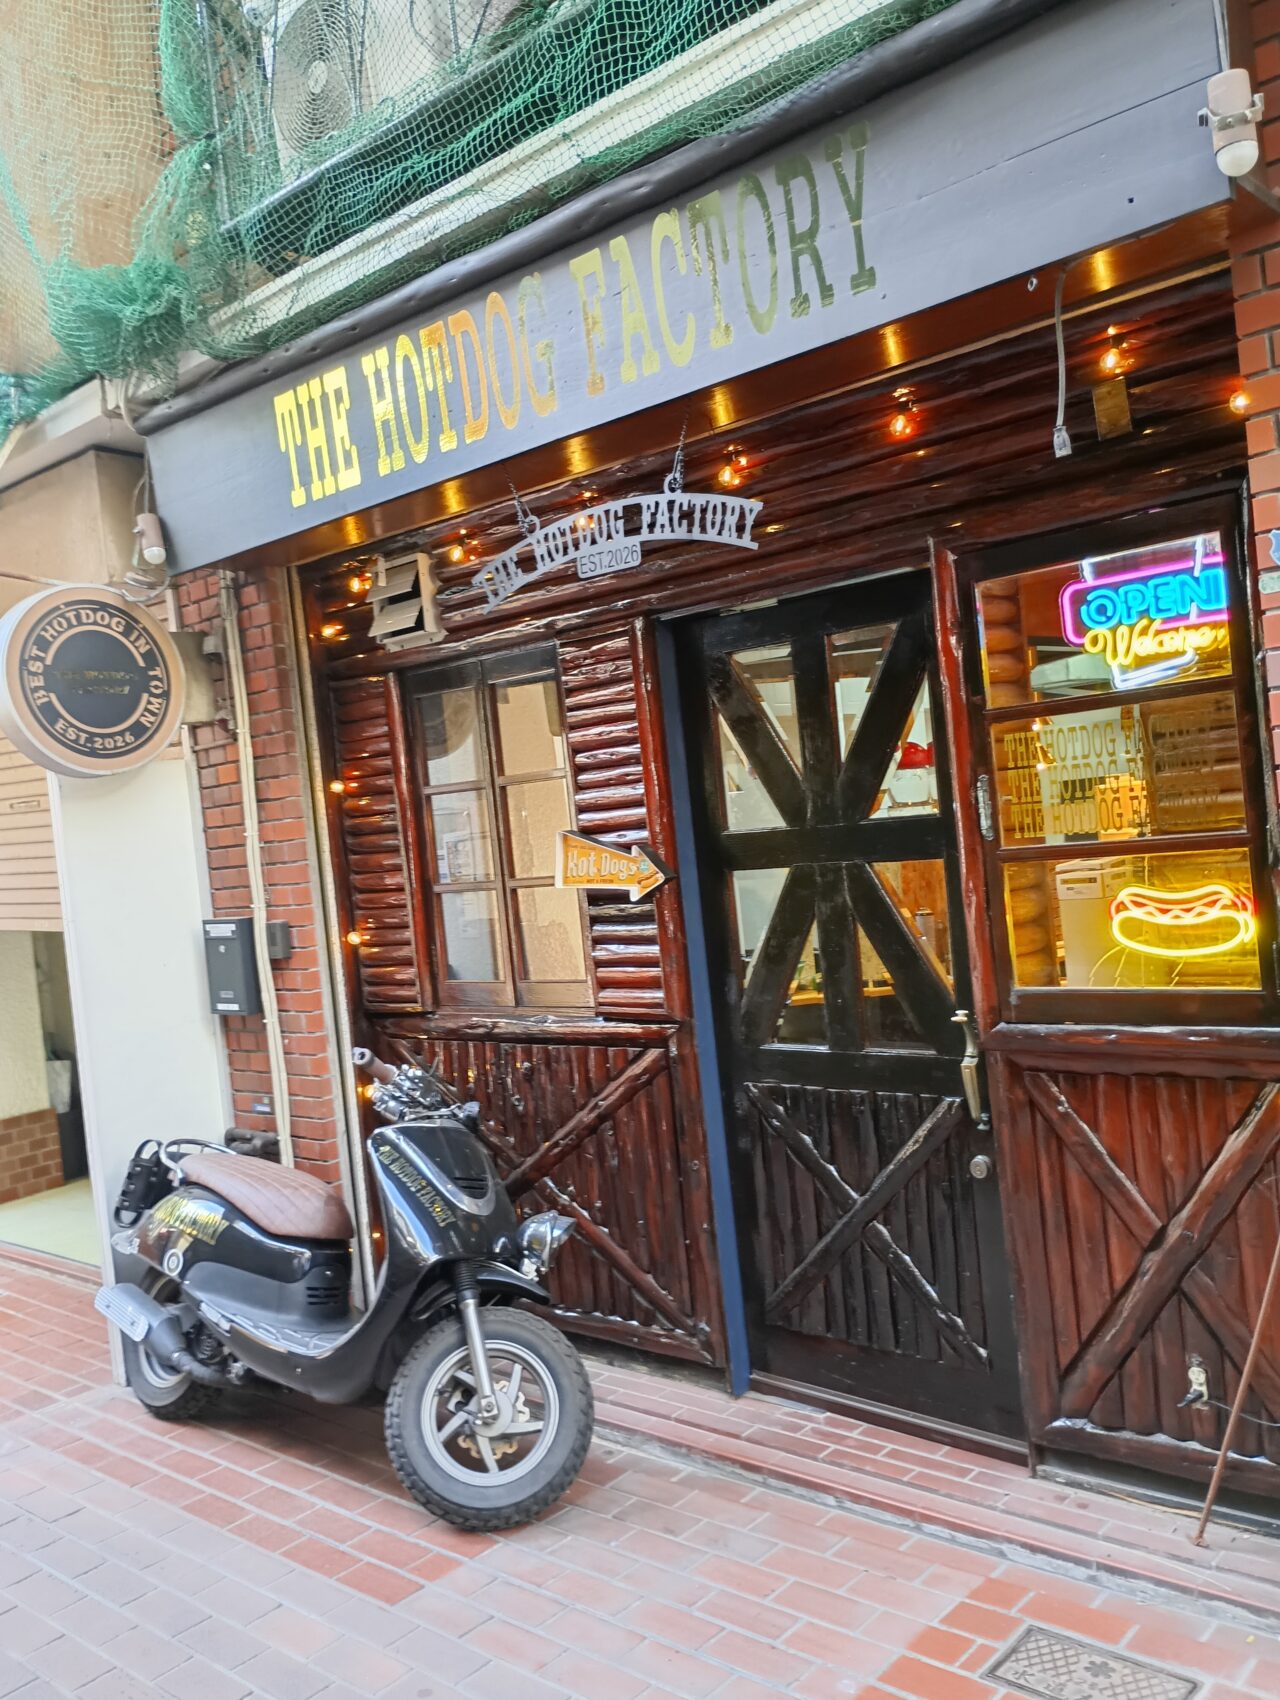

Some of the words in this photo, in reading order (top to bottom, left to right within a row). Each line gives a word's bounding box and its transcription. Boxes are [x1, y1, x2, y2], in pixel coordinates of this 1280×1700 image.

[274, 365, 362, 508] THE
[361, 271, 559, 478] HOTDOG
[568, 119, 877, 397] FACTORY
[534, 508, 625, 569] HOTDOG
[641, 497, 763, 543] FACTORY
[579, 544, 640, 576] EST.2026
[1080, 567, 1228, 630] OPEN
[40, 608, 127, 642] HOTDOG
[128, 629, 151, 654] IN
[1084, 617, 1217, 667] Welcome
[28, 645, 51, 707] BEST
[138, 666, 166, 728] TOWN
[1004, 731, 1041, 768] THE
[1043, 720, 1117, 763] HOTDOG
[1007, 767, 1043, 804] THE
[1047, 759, 1119, 800] HOTDOG
[1010, 802, 1045, 839] THE
[1051, 796, 1124, 836] HOTDOG
[567, 848, 599, 878] Hot
[601, 852, 639, 880] Dogs
